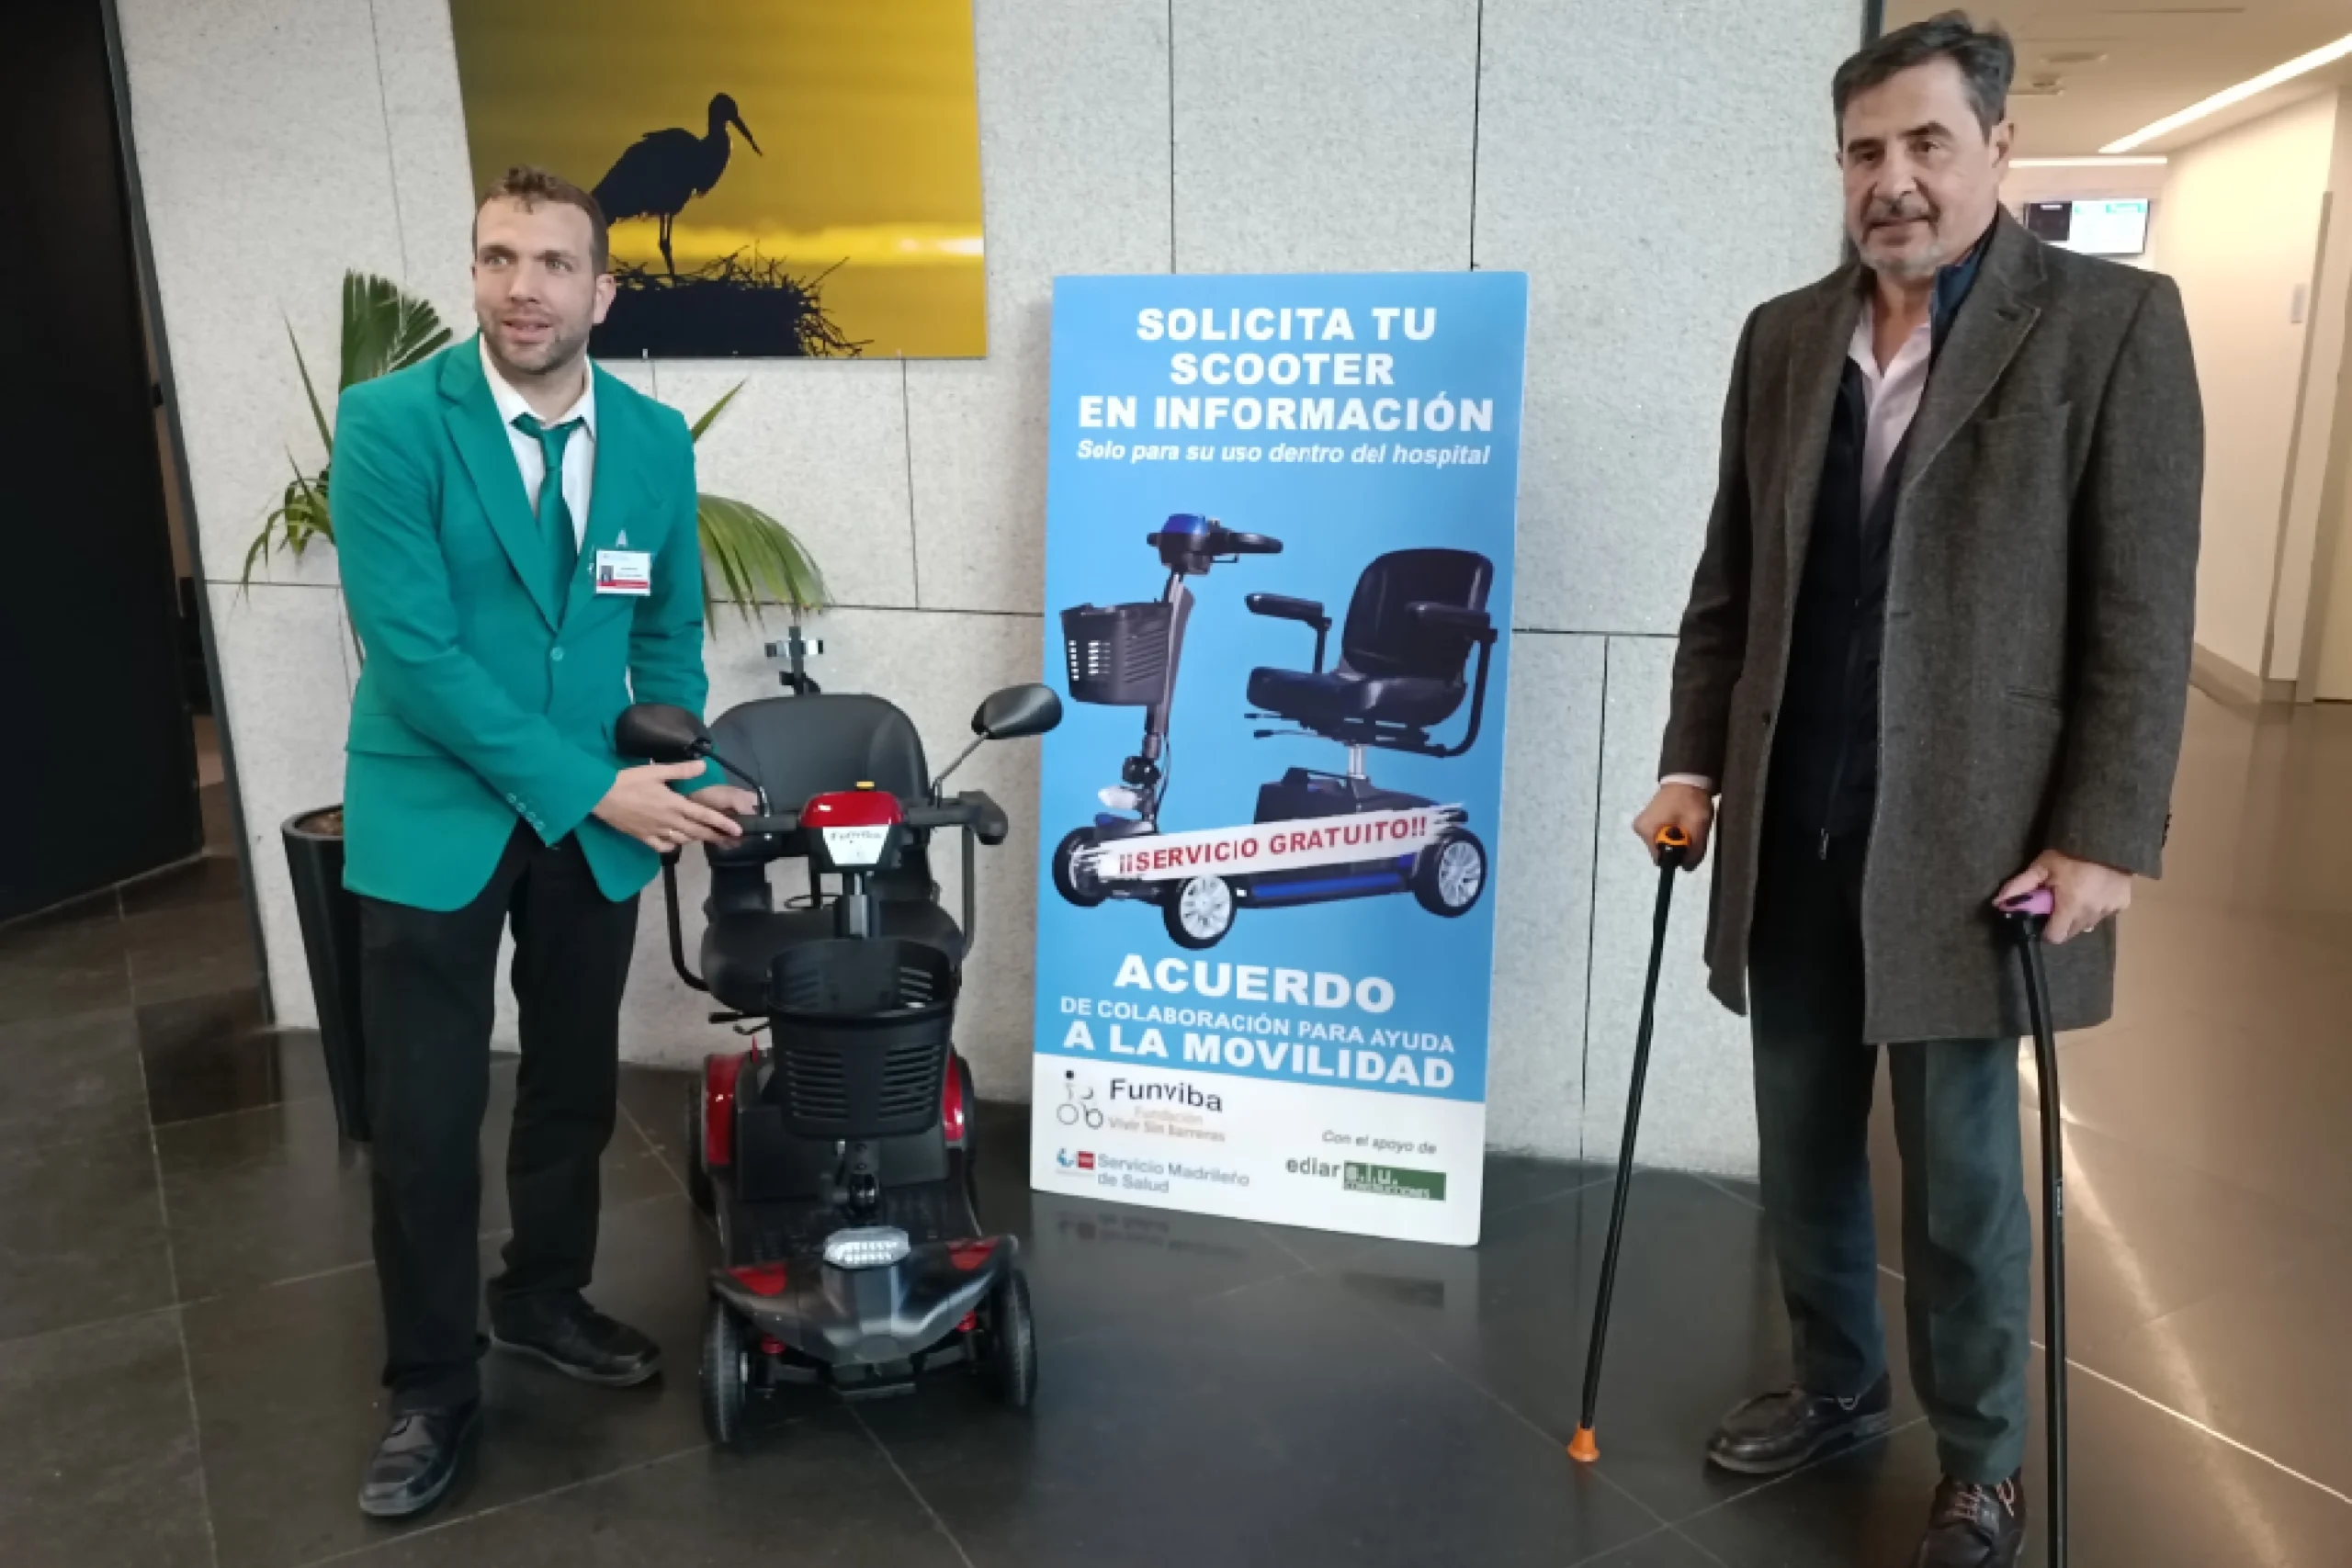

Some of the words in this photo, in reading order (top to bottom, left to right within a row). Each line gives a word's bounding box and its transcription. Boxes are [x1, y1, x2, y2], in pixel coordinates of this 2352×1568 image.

[1136, 307, 1354, 342] SOLICITA
[1371, 307, 1437, 341] TU
[1170, 352, 1395, 386] SCOOTER
[1078, 395, 1136, 428] EN
[1155, 391, 1494, 432] INFORMACIÓN
[1077, 438, 1125, 459] Solo
[1131, 444, 1180, 464] para
[1185, 446, 1214, 462] su
[1221, 446, 1261, 463] uso
[1269, 443, 1344, 464] dentro
[1351, 443, 1386, 464] del
[1392, 444, 1490, 468] hospital
[1119, 838, 1258, 874] ¡¡SERVICIO
[1270, 817, 1427, 855] GRATUITO!!
[1113, 953, 1396, 1013] ACUERDO
[1060, 997, 1091, 1016] DE
[1097, 999, 1290, 1037] COLABORACIÓN
[1298, 1021, 1365, 1044] PARA
[1370, 1028, 1454, 1054] AYUDA
[1062, 1020, 1094, 1051] A
[1109, 1025, 1169, 1058] LA
[1183, 1032, 1454, 1089] MOVILIDAD
[1109, 1077, 1223, 1113] Funviba
[1098, 1153, 1164, 1175] Servicio
[1097, 1172, 1117, 1187] de
[1122, 1173, 1170, 1194] Salud
